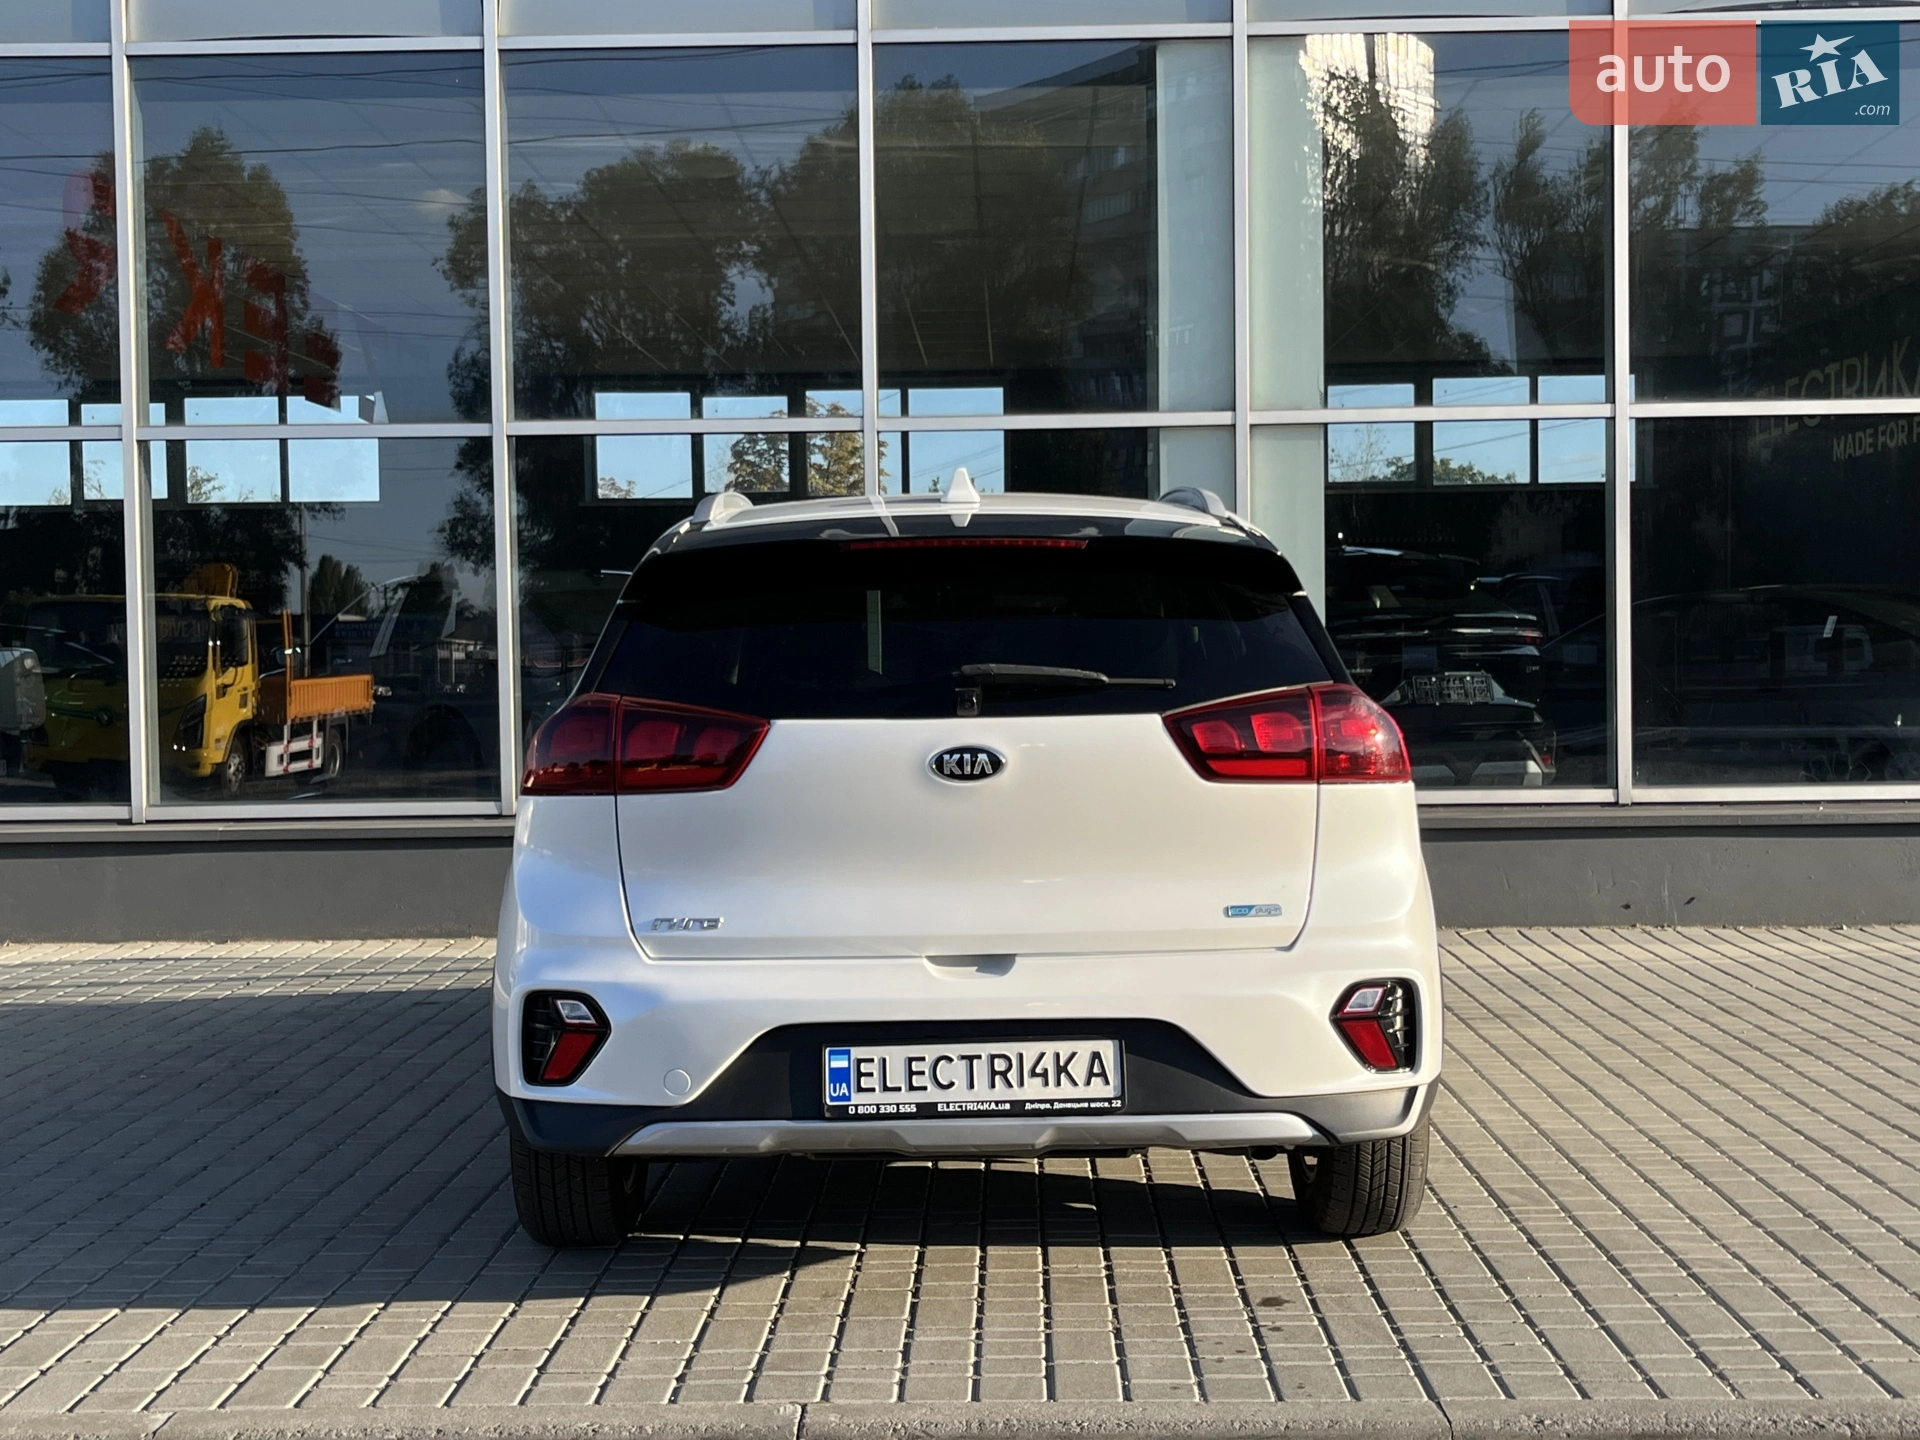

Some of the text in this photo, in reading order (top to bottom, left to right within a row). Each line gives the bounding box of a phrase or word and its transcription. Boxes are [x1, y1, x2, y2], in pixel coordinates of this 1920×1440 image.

[1832, 427, 1875, 463] MADE
[1877, 419, 1909, 452] FOR
[943, 753, 993, 775] KIA
[853, 1051, 1110, 1094] ELECTRI4KA
[830, 1083, 849, 1097] UA
[848, 1101, 1011, 1114] 0 800 330 555 ELECTRI4KA.ua
[1111, 1099, 1122, 1108] 22
